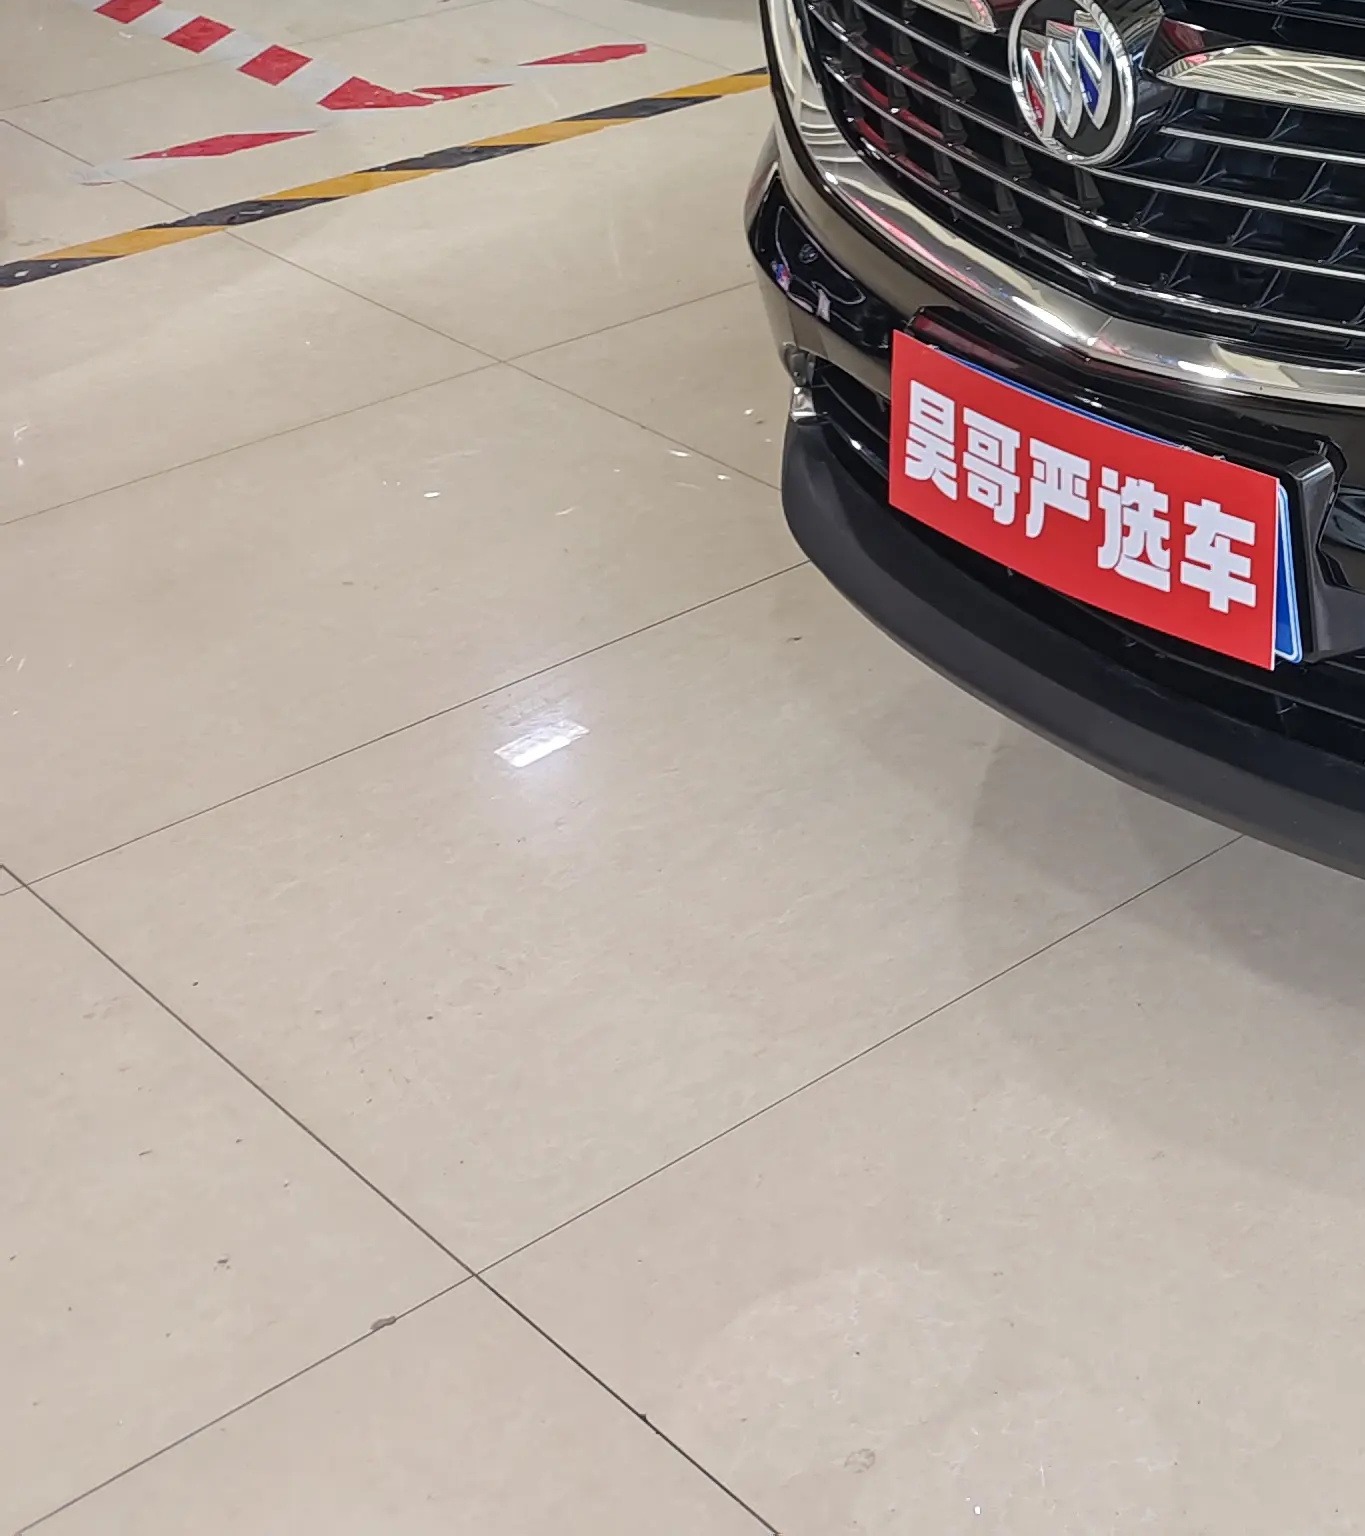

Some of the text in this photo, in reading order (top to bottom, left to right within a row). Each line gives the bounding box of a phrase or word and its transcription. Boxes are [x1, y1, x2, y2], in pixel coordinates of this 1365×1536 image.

[903, 379, 1258, 614] 昊哥严选车
